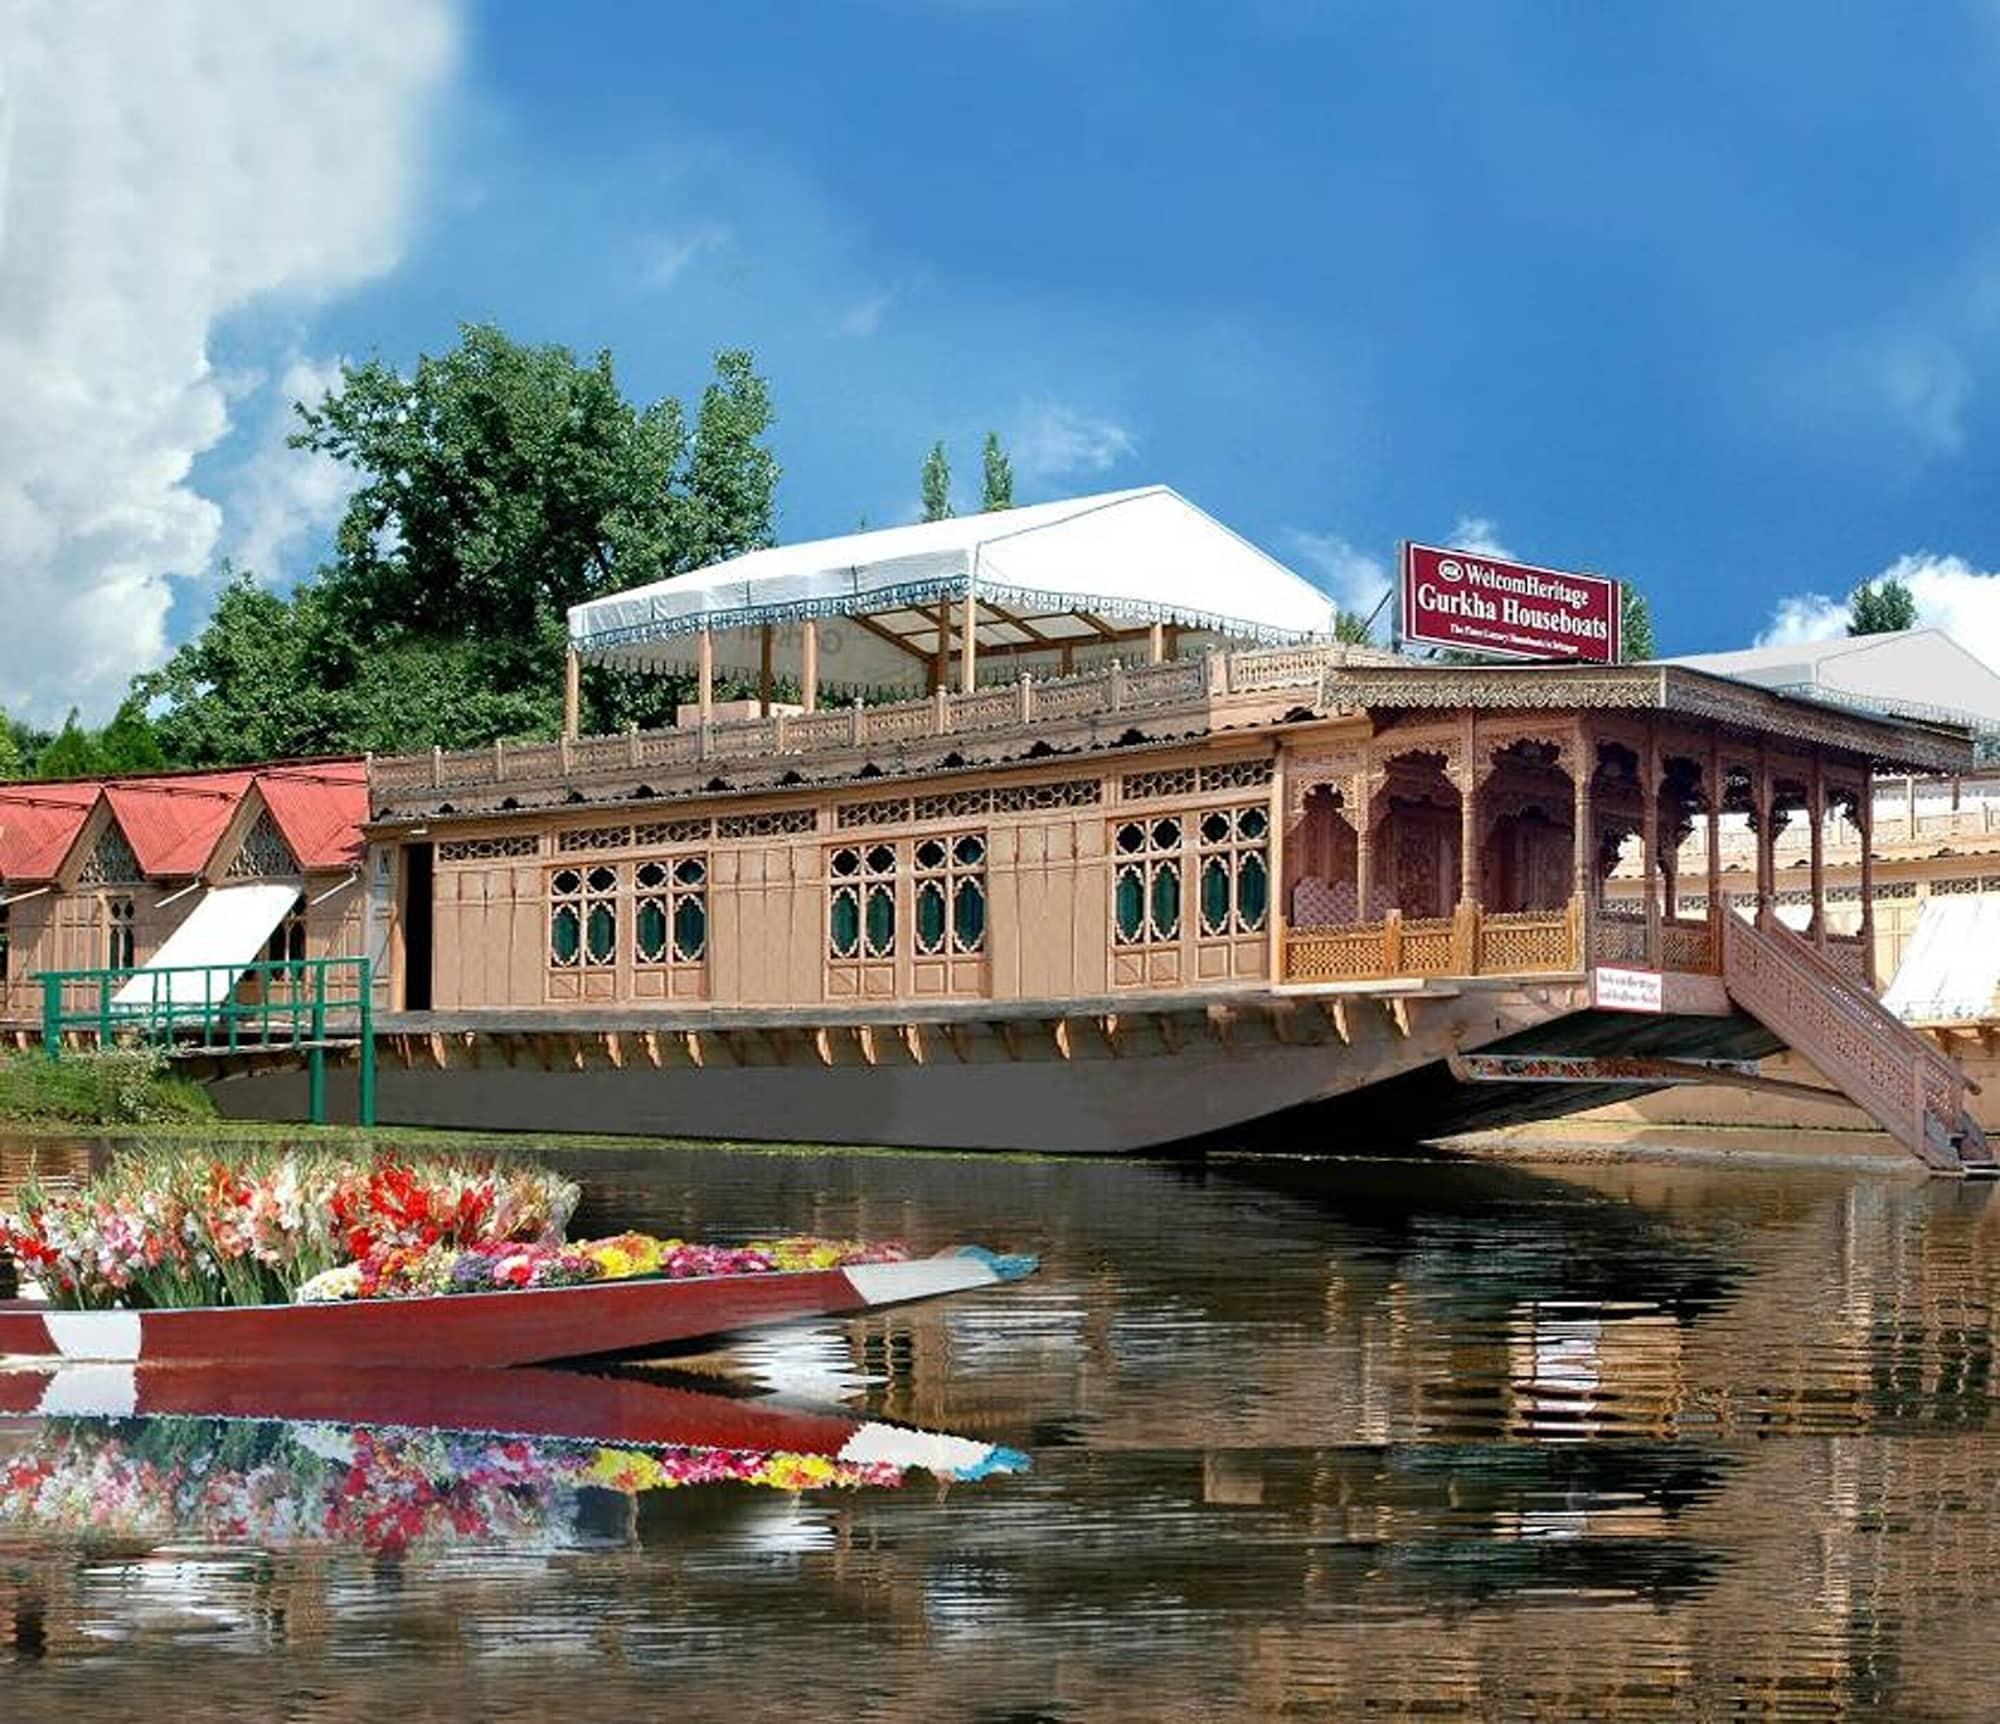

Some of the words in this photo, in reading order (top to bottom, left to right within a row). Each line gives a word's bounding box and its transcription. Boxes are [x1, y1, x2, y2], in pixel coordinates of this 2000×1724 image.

[1418, 583, 1497, 622] Gurkha
[1502, 597, 1608, 639] Houseboats
[1465, 563, 1589, 610] WelcomHeritage
